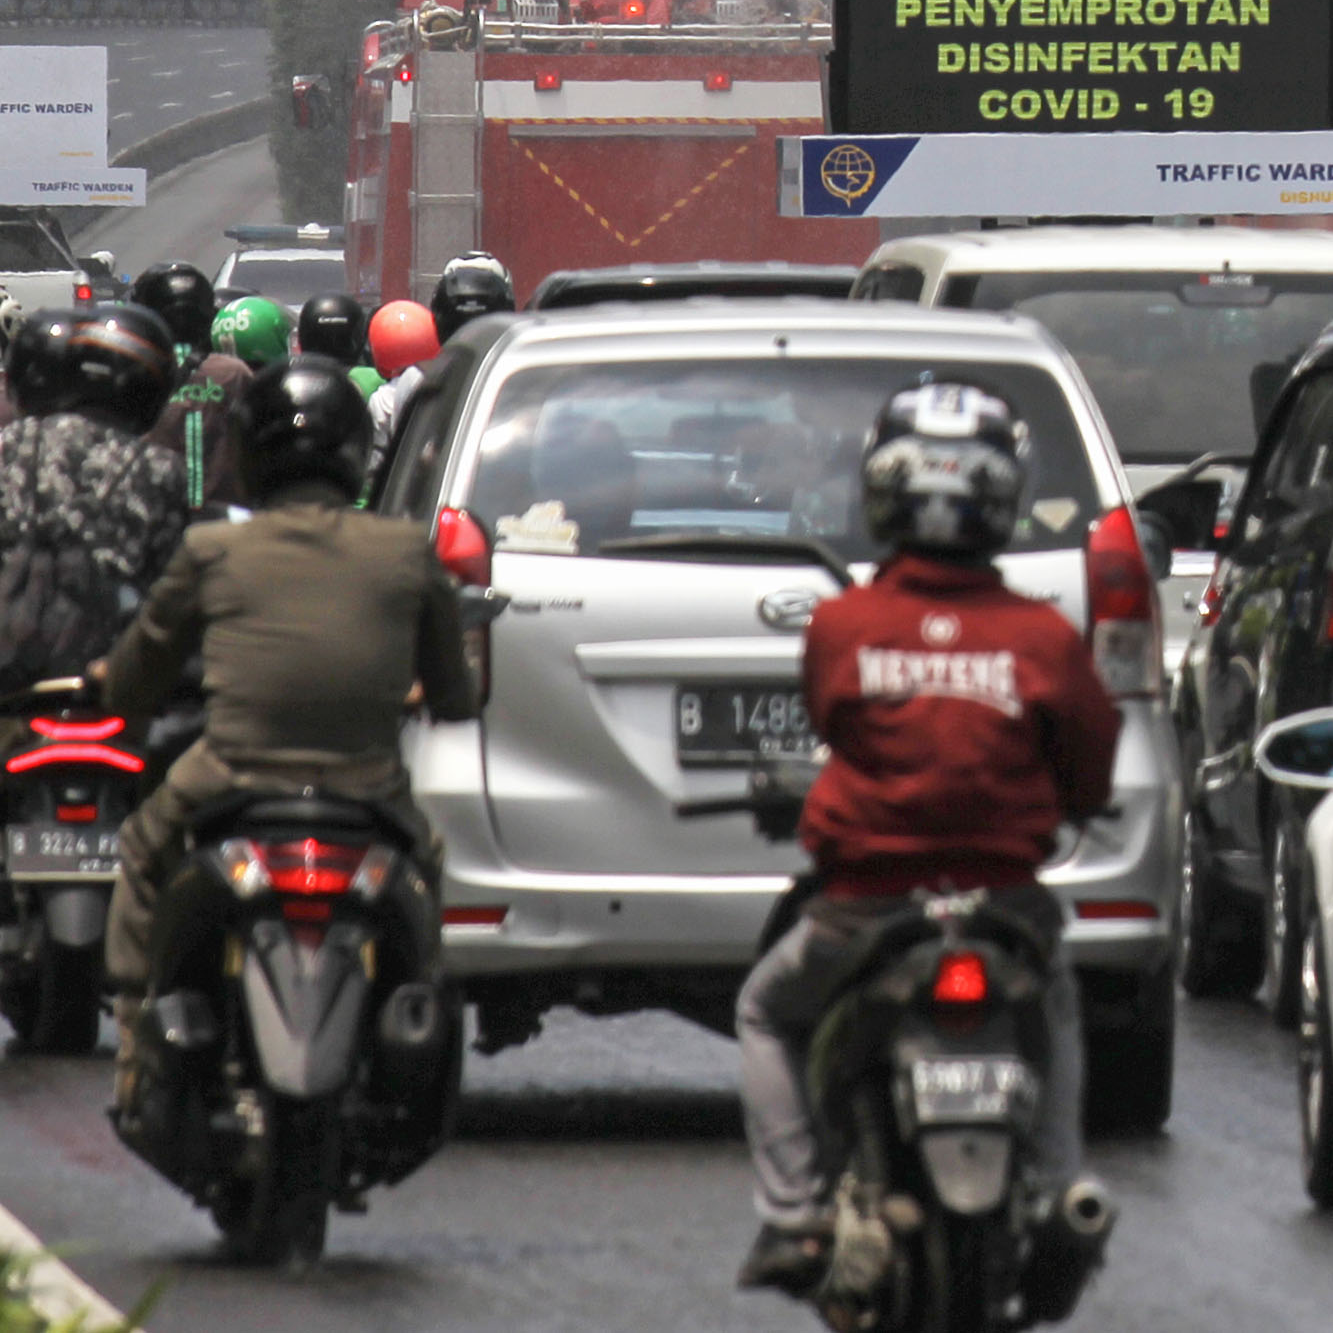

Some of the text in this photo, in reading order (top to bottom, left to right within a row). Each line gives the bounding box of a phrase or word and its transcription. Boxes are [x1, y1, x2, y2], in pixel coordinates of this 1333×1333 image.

[937, 41, 1241, 74] DISINFEKTAN
[35, 103, 93, 114] WARDEN
[978, 87, 1215, 121] COVID - 19
[1156, 164, 1261, 183] TRAFFIC
[32, 181, 133, 193] TRAFFIC WARDEN
